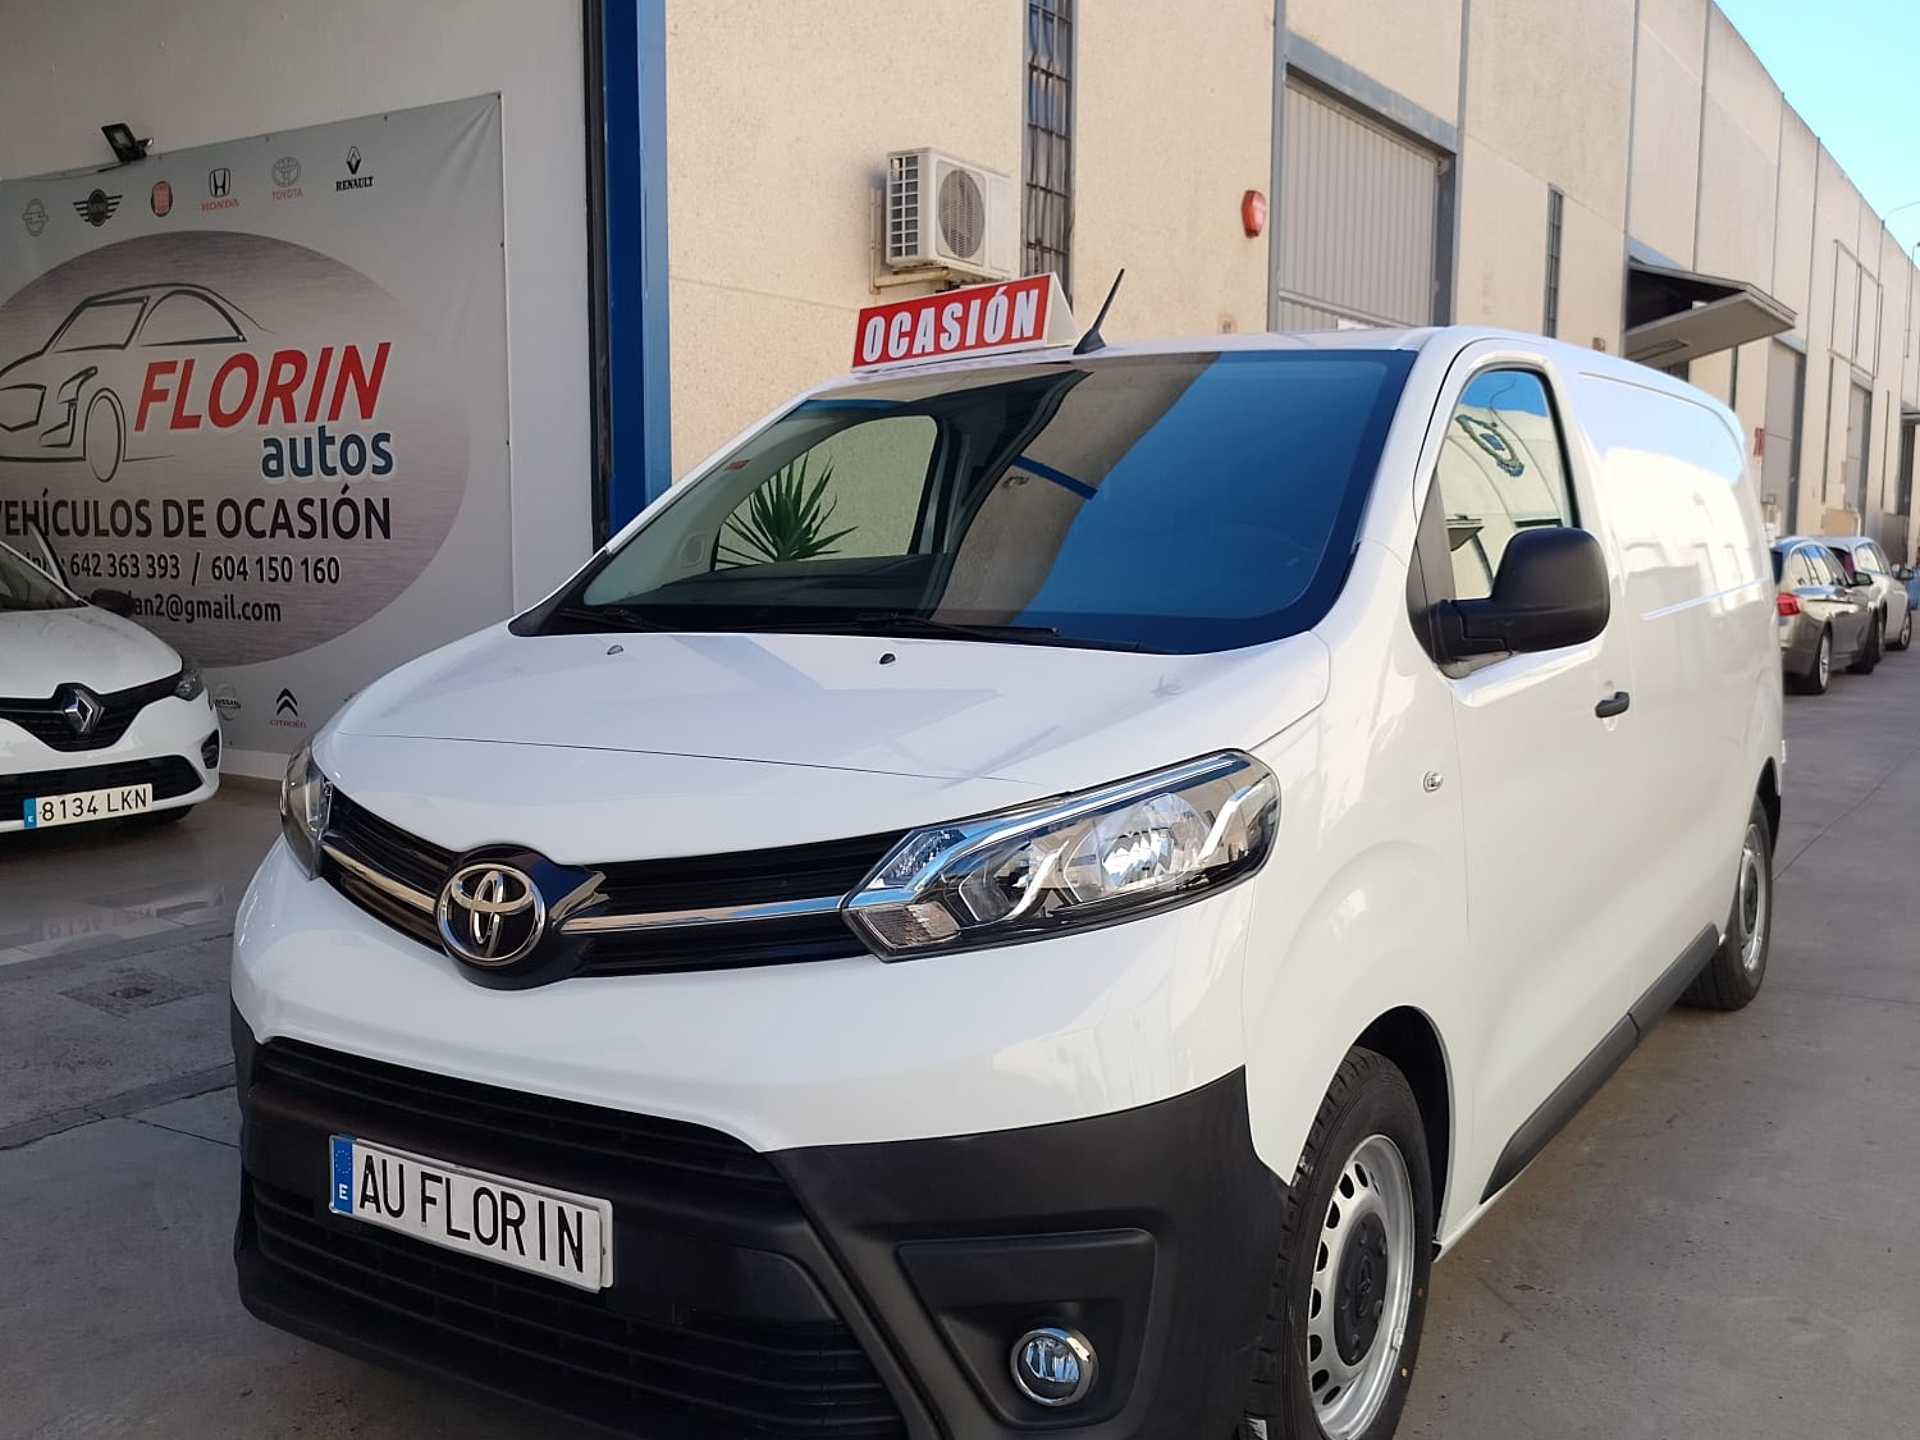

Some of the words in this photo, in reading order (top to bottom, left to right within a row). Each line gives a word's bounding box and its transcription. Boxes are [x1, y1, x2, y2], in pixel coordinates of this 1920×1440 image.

[271, 188, 303, 201] TOYOTA
[335, 176, 374, 192] RENAULT
[201, 199, 240, 212] HONDA
[862, 285, 1039, 363] OCASIÓN
[134, 342, 392, 432] FLORIN
[261, 424, 394, 479] autos
[0, 488, 153, 538] EHÍCULOS
[162, 499, 207, 538] DE
[216, 483, 391, 540] OCASIÓN
[70, 552, 102, 578] 642
[107, 554, 140, 579] 363
[146, 555, 181, 579] 393
[191, 552, 201, 586] /
[211, 557, 249, 582] 604
[255, 556, 293, 583] 150
[300, 557, 340, 584] 160
[128, 593, 282, 622] an2@gmail.com
[41, 795, 98, 822] 8134
[107, 789, 147, 813] LKN
[339, 1183, 348, 1200] E
[359, 1154, 406, 1219] AU
[420, 1171, 584, 1273] FLORIN
